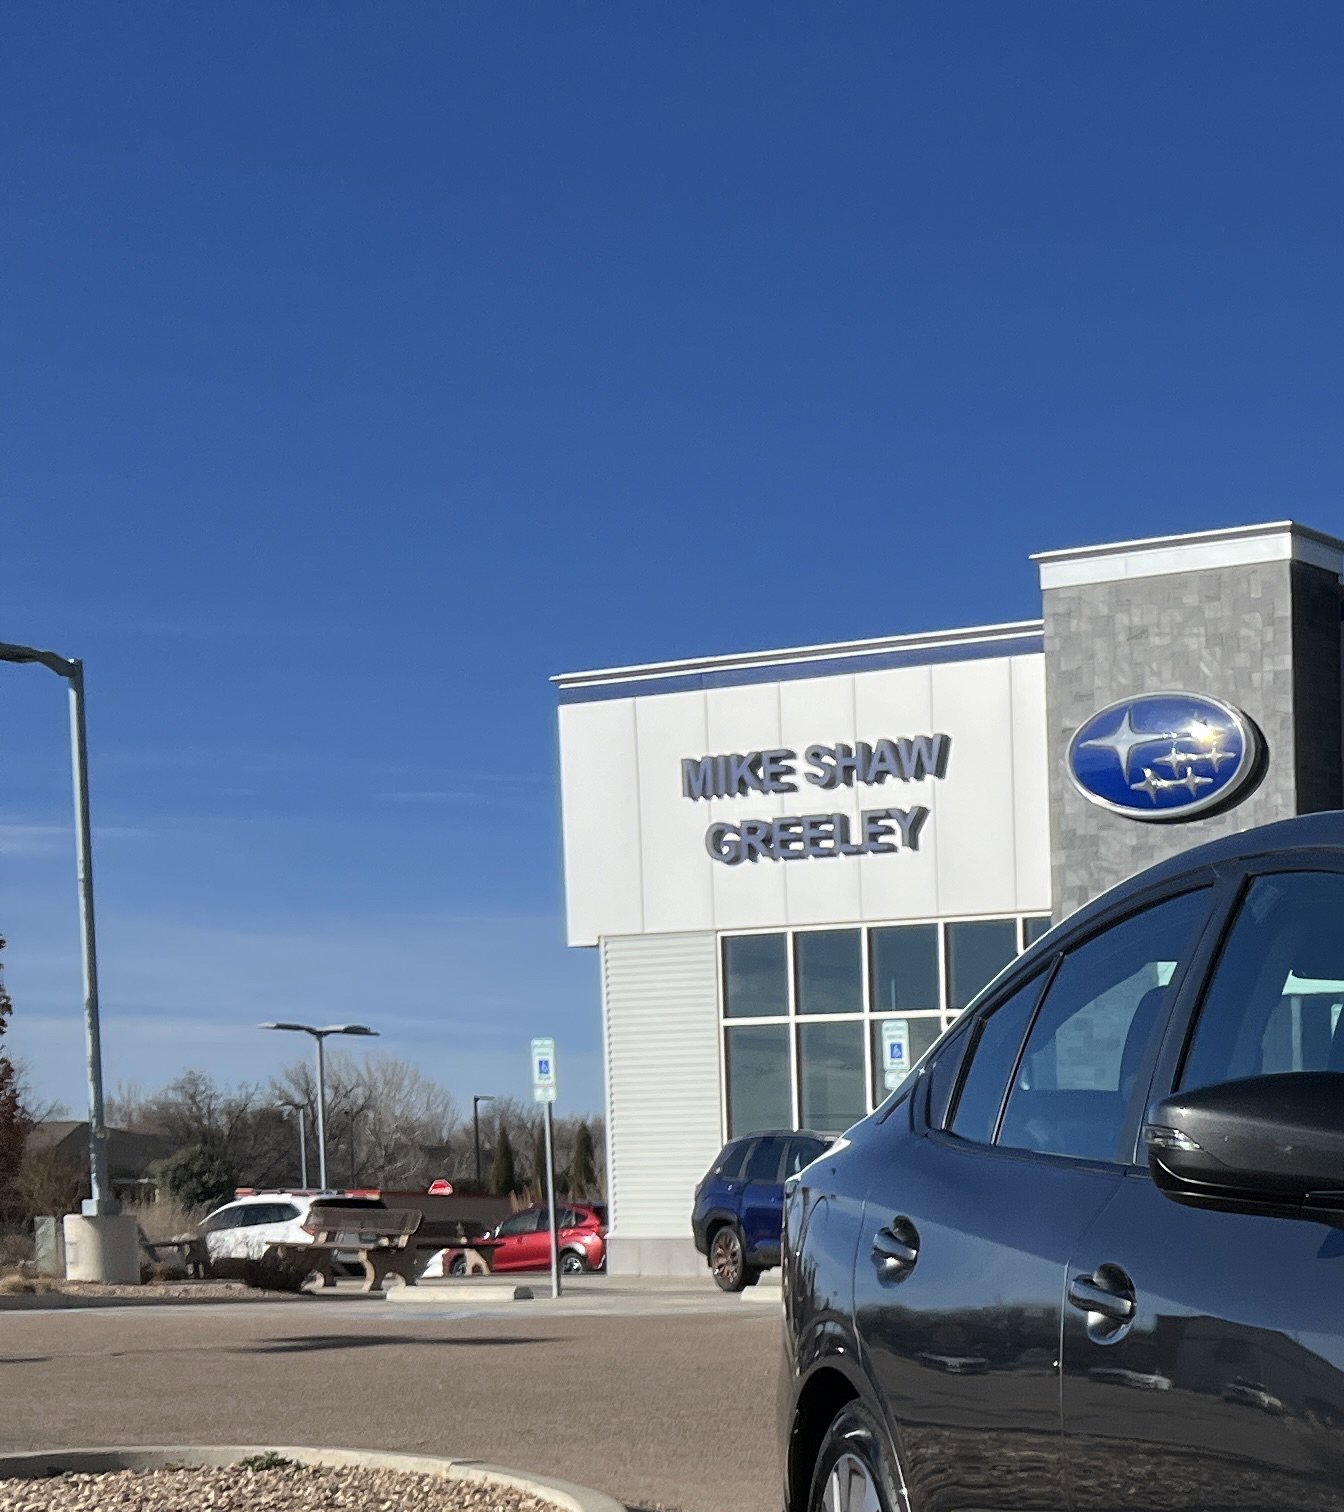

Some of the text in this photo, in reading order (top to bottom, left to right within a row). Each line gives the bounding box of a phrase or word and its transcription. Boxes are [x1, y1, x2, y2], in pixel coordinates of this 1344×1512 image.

[681, 733, 952, 801] MIKE SHAW
[705, 806, 930, 866] GREELEY
